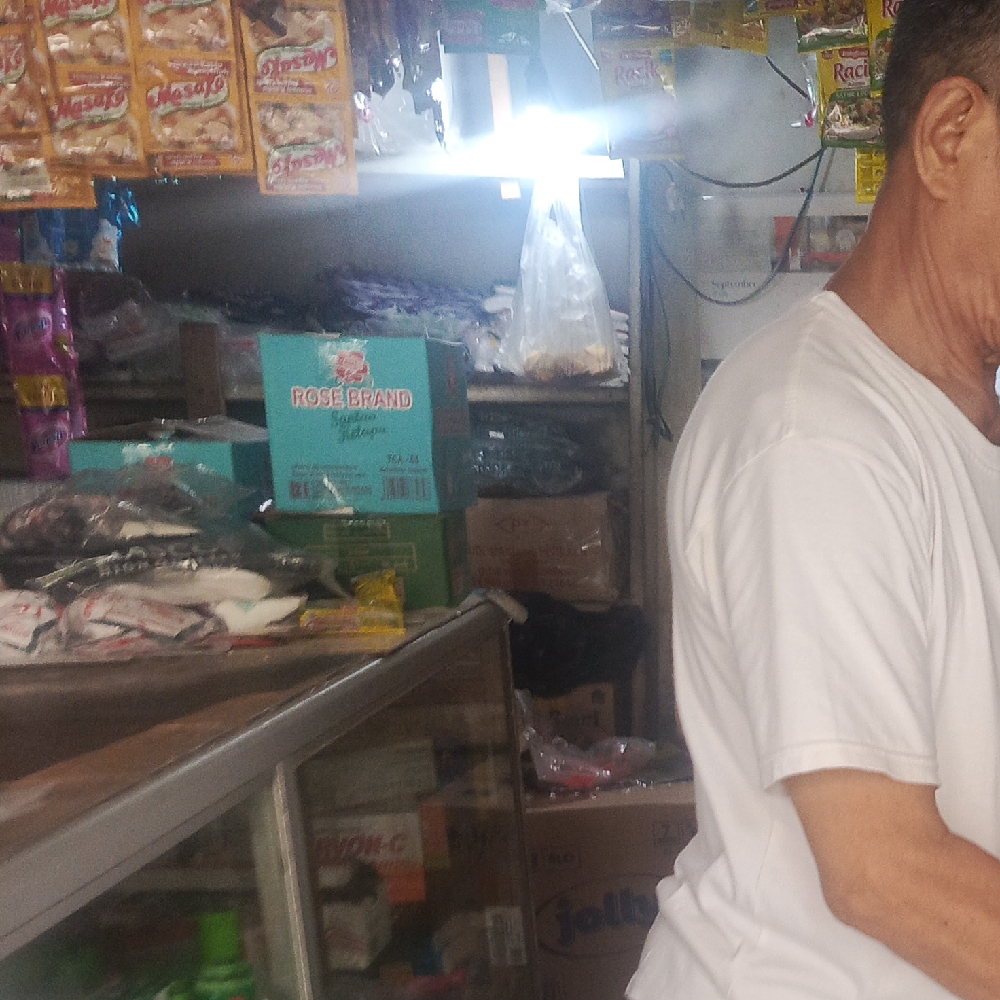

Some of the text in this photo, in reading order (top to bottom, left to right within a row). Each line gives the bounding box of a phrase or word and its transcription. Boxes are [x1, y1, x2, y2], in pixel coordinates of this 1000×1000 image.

[261, 47, 338, 80] Masako
[834, 59, 869, 82] Raci
[291, 386, 413, 411] ROSE BRAND
